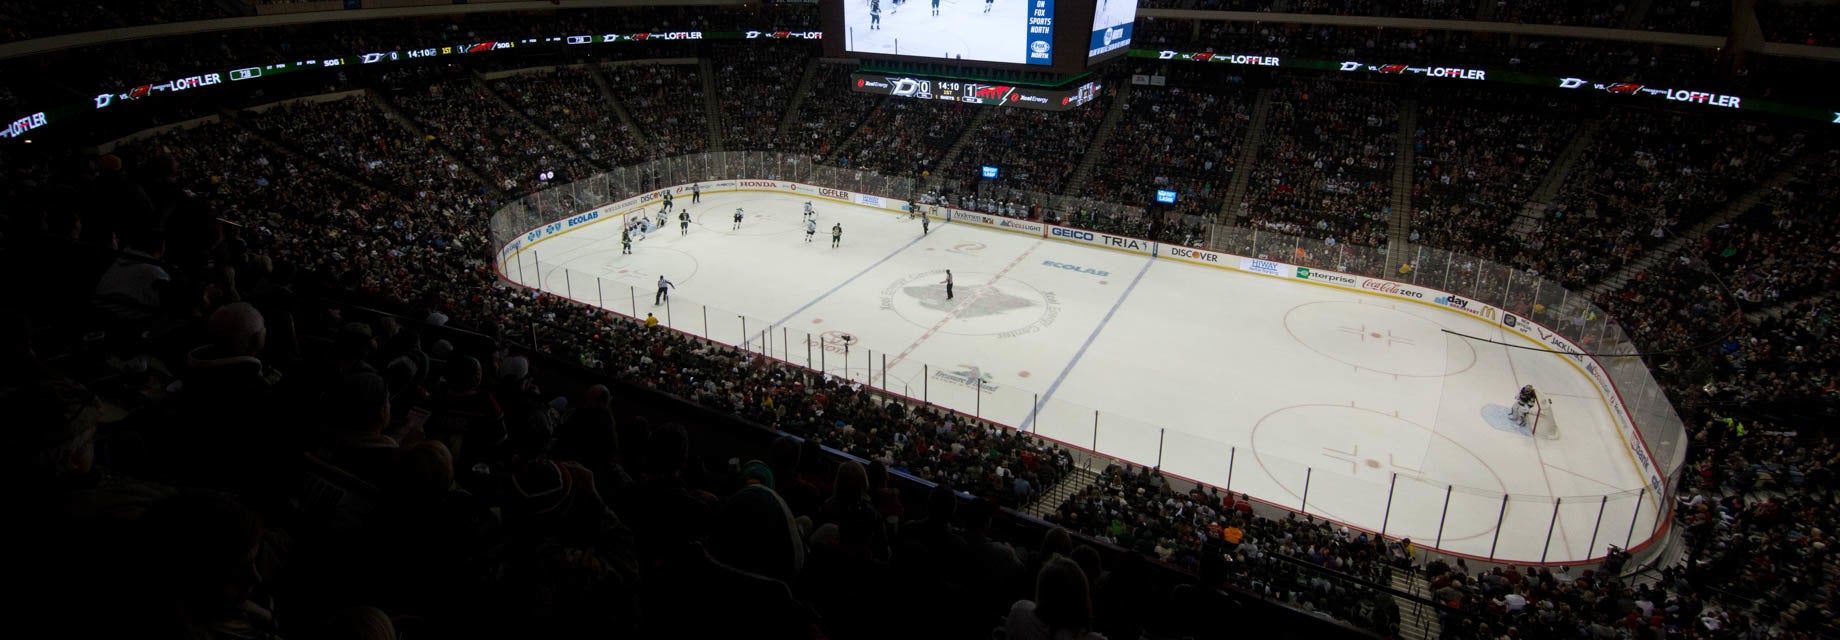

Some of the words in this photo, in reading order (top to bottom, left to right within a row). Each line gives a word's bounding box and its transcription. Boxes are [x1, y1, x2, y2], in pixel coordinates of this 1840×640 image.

[1034, 8, 1045, 16] FOX
[1029, 17, 1051, 25] SPORTS
[1030, 25, 1050, 34] NORTH
[664, 32, 702, 40] LOFFLER
[408, 49, 430, 58] 14:10
[323, 59, 340, 67] SOG
[1231, 55, 1280, 66] LOFFLER
[1426, 66, 1485, 80] LOFFLER
[170, 73, 221, 92] LOFFLER
[920, 81, 929, 92] 0
[938, 81, 960, 90] 14:10
[1666, 88, 1741, 109] LOFFLER
[8, 111, 47, 138] LOFFLER
[818, 187, 849, 198] LOFFLER
[568, 211, 599, 227] ECOLAB
[1025, 224, 1041, 232] LIGHT
[1052, 227, 1094, 241] GEICO
[1102, 235, 1139, 250] TRIA
[1171, 247, 1218, 262] DISCOVER
[1042, 260, 1110, 277] ECOLAB
[1400, 288, 1423, 299] zero
[1434, 297, 1448, 306] all
[1447, 295, 1468, 308] day
[1551, 337, 1566, 352] JACK
